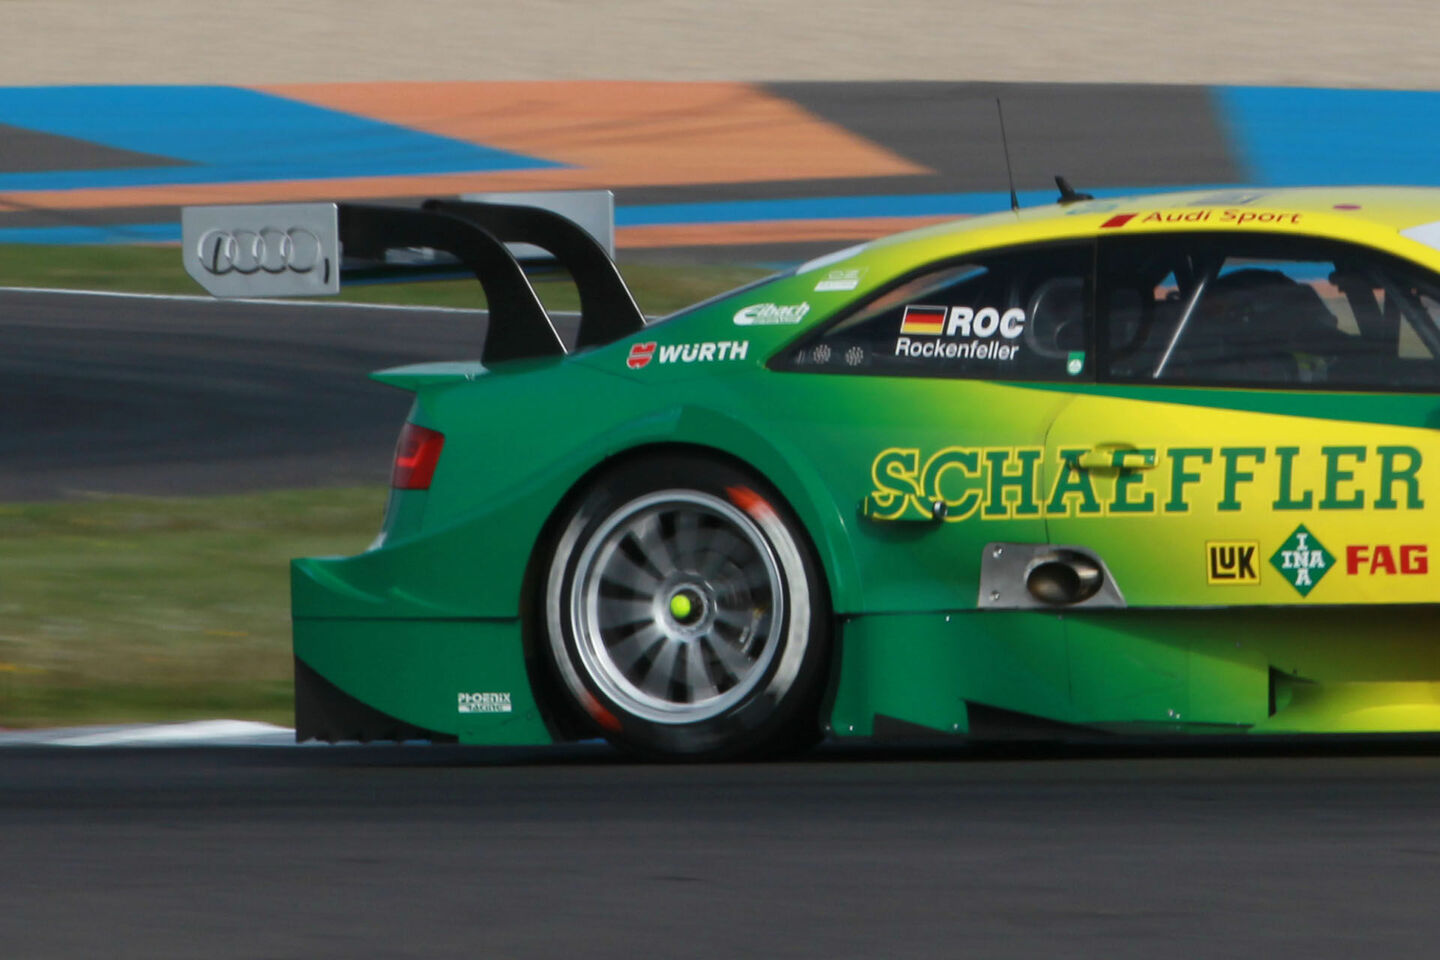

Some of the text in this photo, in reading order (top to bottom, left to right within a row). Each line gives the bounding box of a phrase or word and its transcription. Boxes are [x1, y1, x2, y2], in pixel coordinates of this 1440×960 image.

[1141, 209, 1303, 225] Audi Sport
[946, 306, 1026, 339] ROC
[895, 337, 1019, 361] Rockenfeller
[871, 443, 1425, 522] SCHAEFFLER
[1346, 545, 1429, 576] FAG
